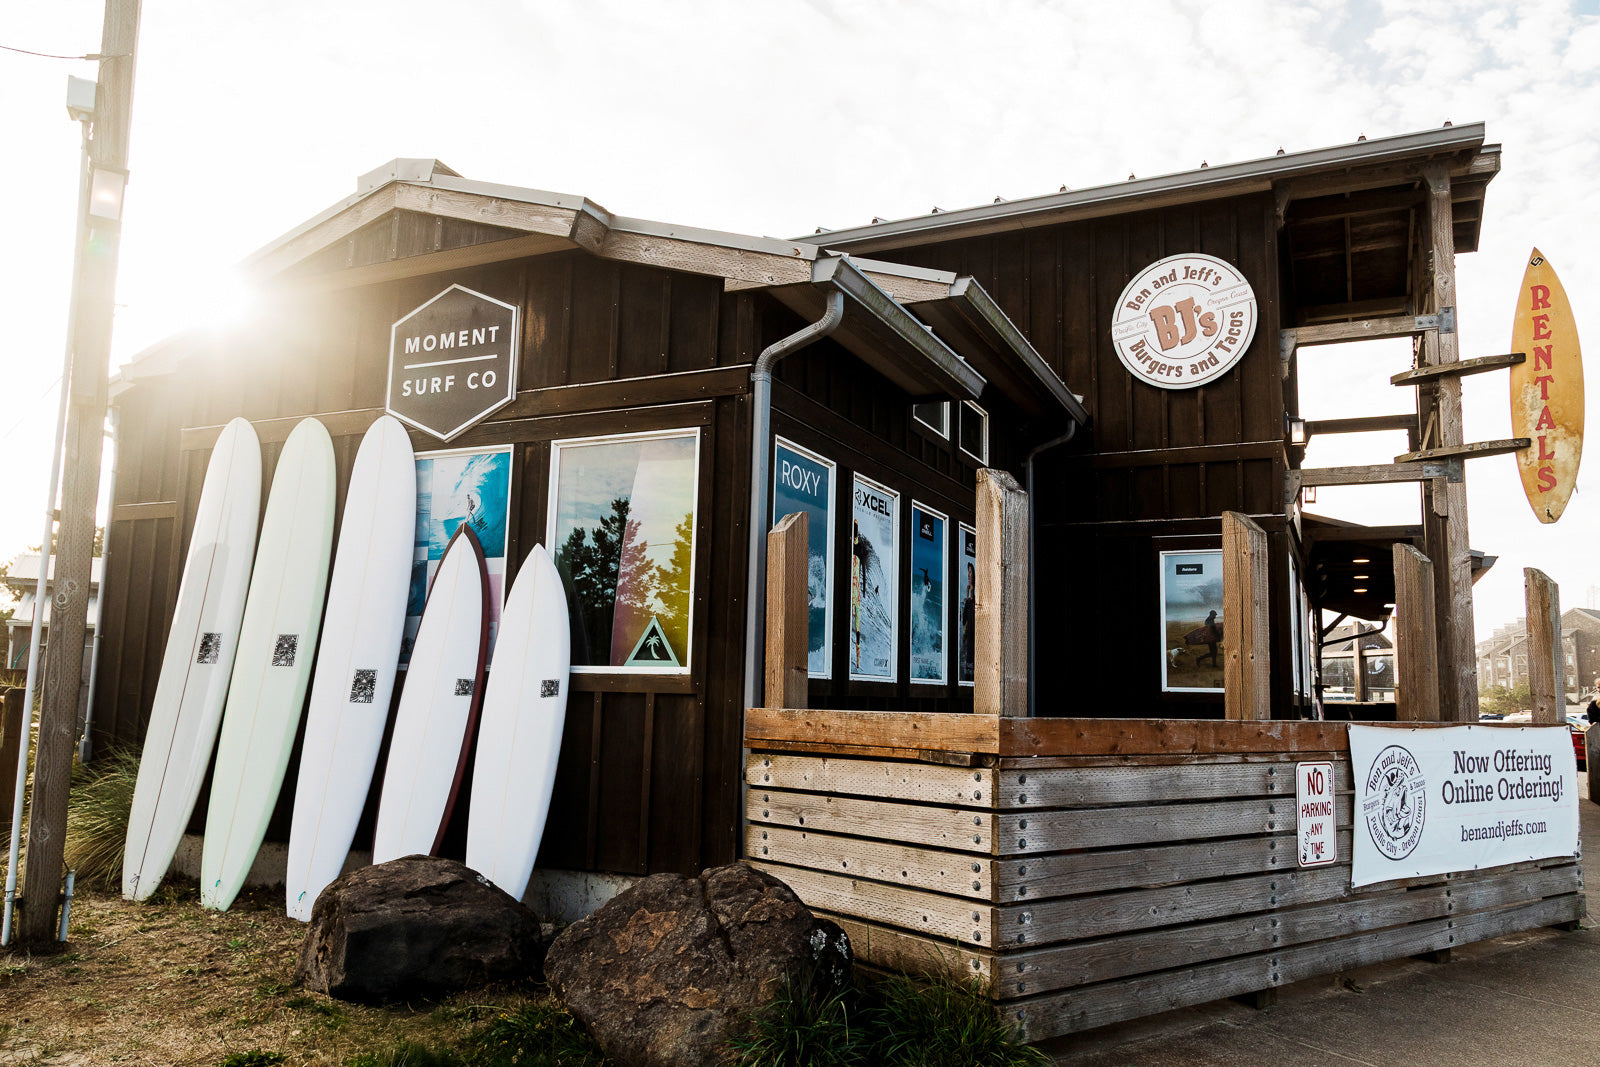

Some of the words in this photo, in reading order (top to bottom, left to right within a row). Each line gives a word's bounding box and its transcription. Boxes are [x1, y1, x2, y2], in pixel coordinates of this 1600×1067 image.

[1126, 288, 1152, 311] Ben
[1152, 268, 1178, 290] and
[1182, 265, 1222, 286] Jeff's
[1149, 296, 1219, 352] BJ's
[404, 325, 500, 354] MOMENT
[1129, 338, 1183, 378] Burgers
[1189, 351, 1220, 376] and
[1214, 310, 1244, 354] Tacos
[401, 375, 456, 397] SURF
[467, 370, 497, 389] CO
[1530, 284, 1557, 494] RENTALS
[781, 459, 821, 497] ROXY
[862, 491, 890, 517] XCEL
[1369, 767, 1382, 792] Ben
[1381, 750, 1396, 770] and
[1396, 751, 1415, 776] Jeff's
[1453, 750, 1490, 774] Now
[1493, 749, 1552, 776] Offering
[1307, 770, 1324, 796] NO
[1441, 779, 1494, 805] Online
[1497, 774, 1563, 802] Ordering!
[1301, 800, 1332, 819] PARKING
[1363, 799, 1380, 812] Burgers
[1310, 822, 1324, 836] ANY
[1370, 815, 1387, 848] Pacific
[1386, 842, 1398, 856] City
[1401, 827, 1419, 852] Oregon
[1461, 819, 1547, 842] benandjeffs.com
[1310, 841, 1325, 856] TIME
